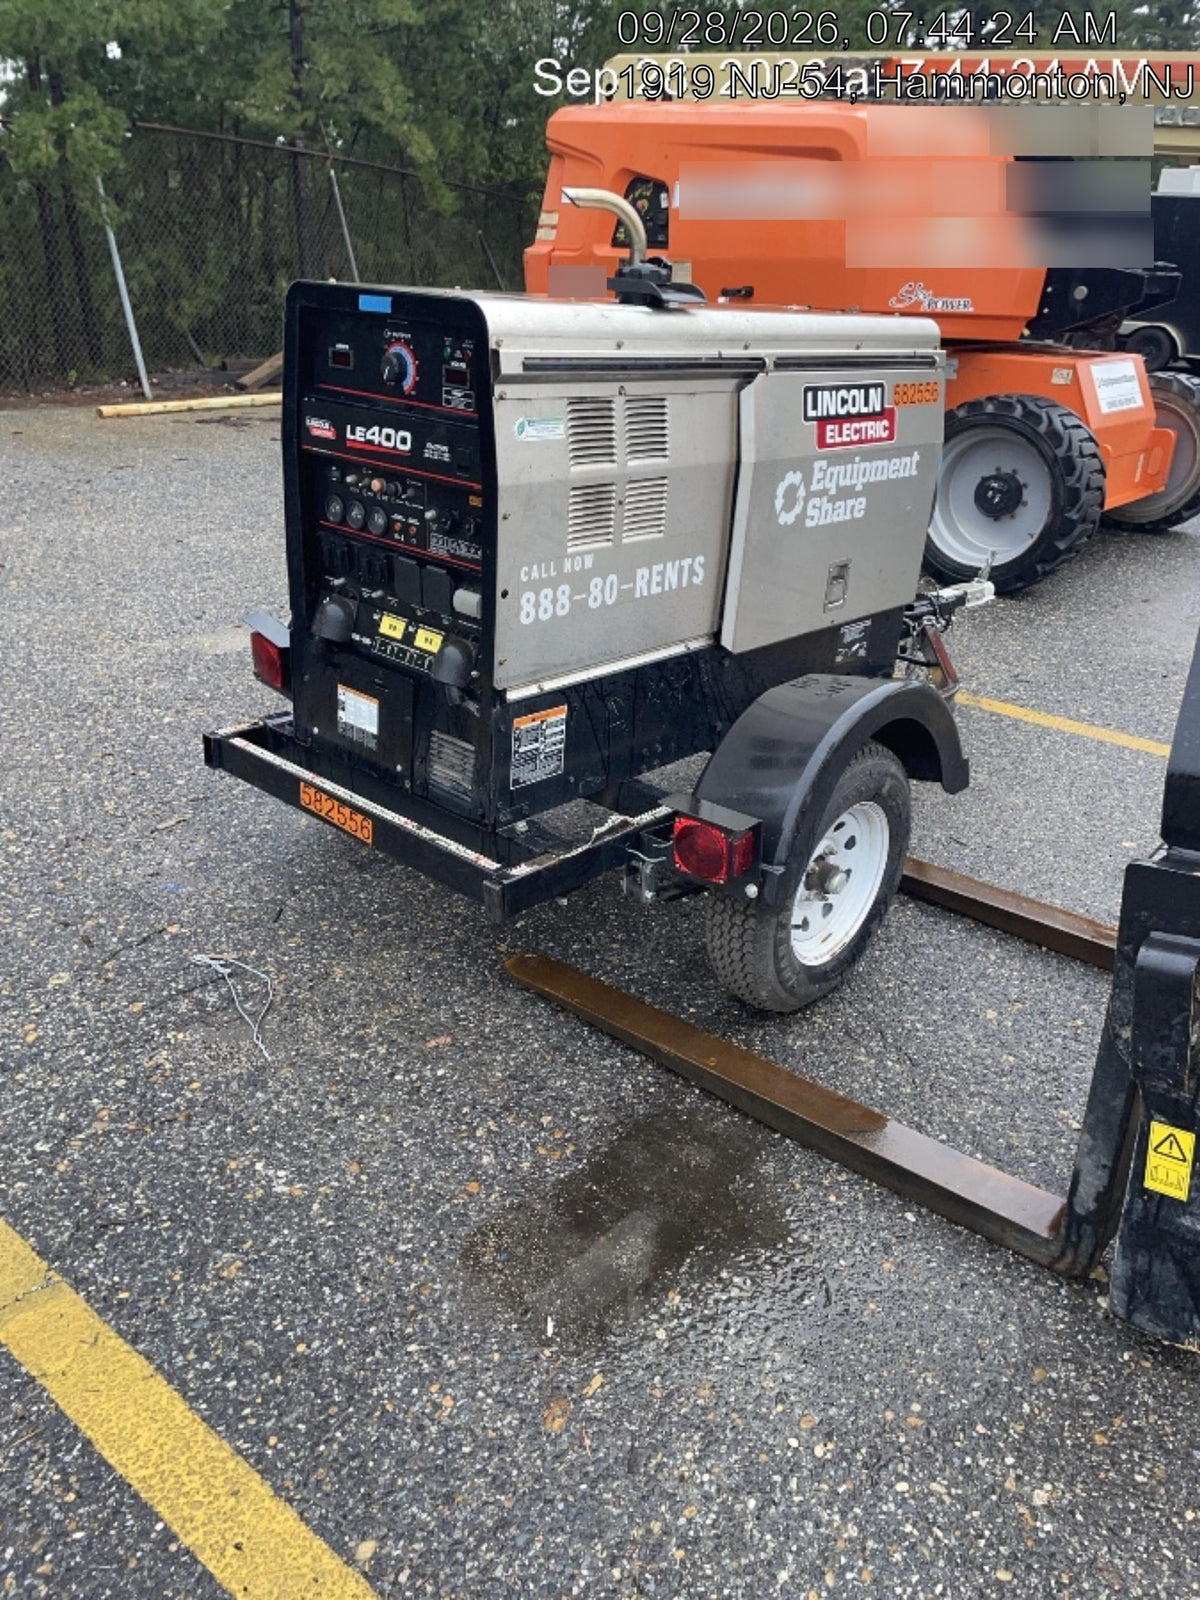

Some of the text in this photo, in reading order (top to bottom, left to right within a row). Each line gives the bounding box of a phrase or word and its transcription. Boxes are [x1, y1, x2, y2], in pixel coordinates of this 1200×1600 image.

[806, 387, 882, 417] LINCOLN
[893, 382, 939, 405] 582556
[346, 424, 412, 452] LE400
[825, 419, 889, 444] ELECTRIC
[810, 451, 920, 495] Equipment
[805, 496, 867, 528] Share
[520, 553, 594, 582] CALL NOW
[520, 555, 705, 625] 888-80-RENTS
[301, 783, 371, 840] 582556
